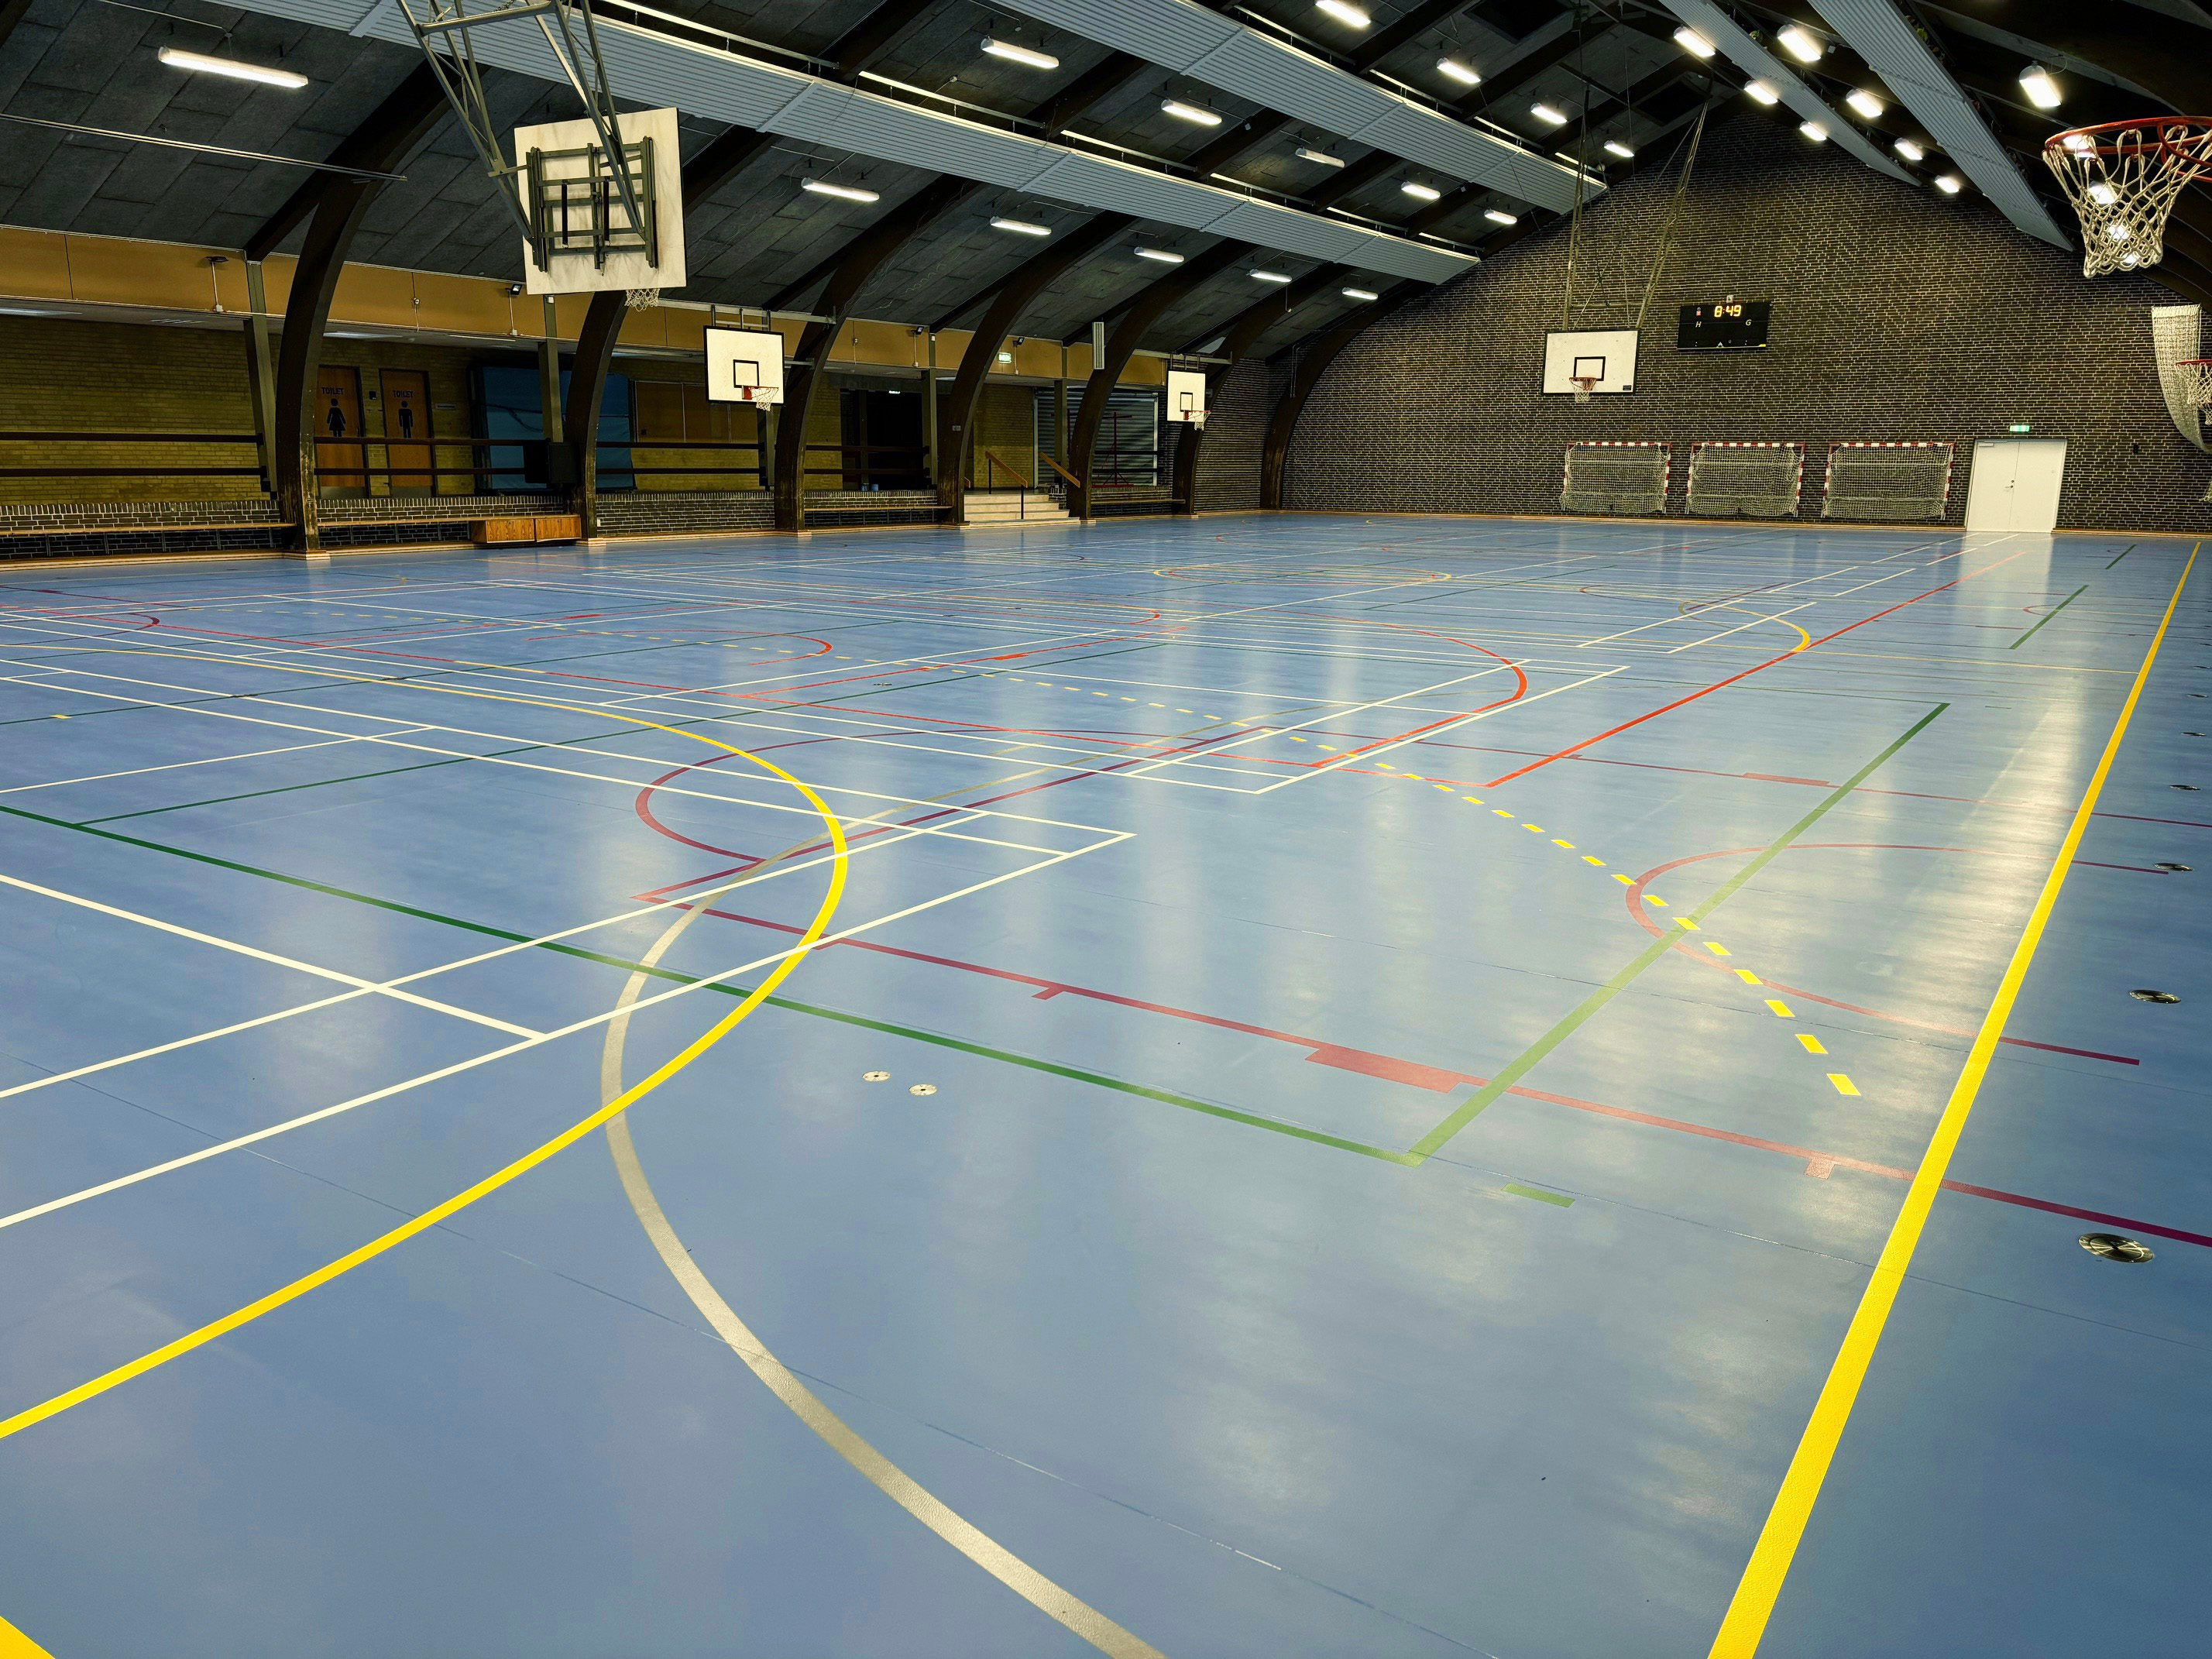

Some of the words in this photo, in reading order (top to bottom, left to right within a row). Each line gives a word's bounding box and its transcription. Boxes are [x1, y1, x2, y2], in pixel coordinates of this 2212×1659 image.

[1714, 305, 1742, 318] 8:49
[321, 386, 344, 395] TOILET
[393, 390, 414, 398] TOILET
